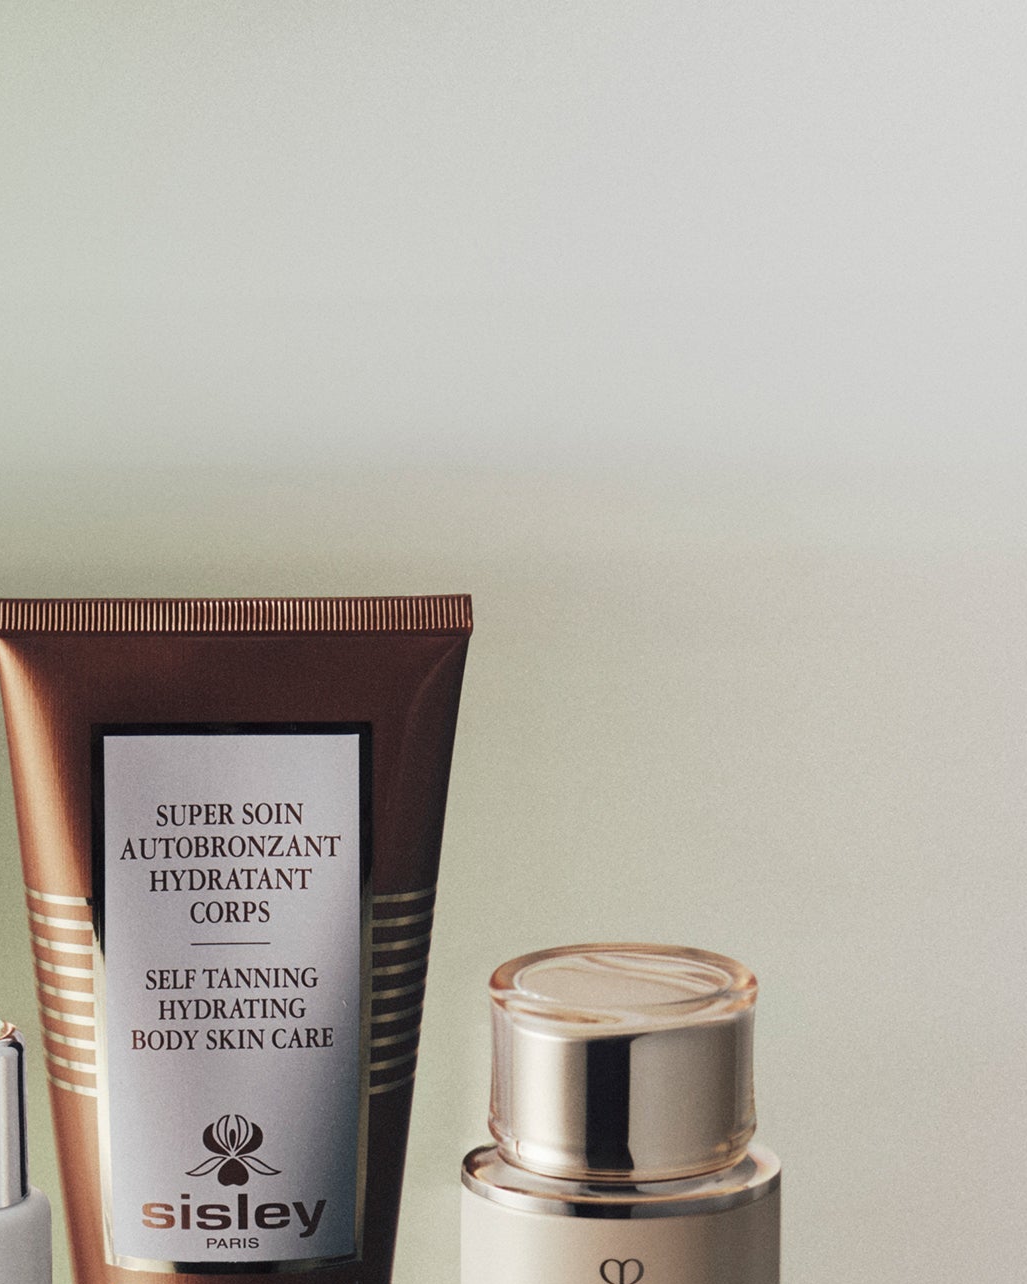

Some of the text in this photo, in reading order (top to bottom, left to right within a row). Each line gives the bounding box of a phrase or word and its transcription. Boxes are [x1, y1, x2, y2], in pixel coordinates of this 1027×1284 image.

[156, 802, 304, 827] SUPER SOIN
[119, 834, 342, 861] AUTOBRONZANT
[149, 867, 313, 892] HYDRATANT
[189, 900, 271, 924] CORPS
[145, 966, 319, 991] SELF TANNING
[158, 997, 307, 1020] HYDRATING
[131, 1027, 334, 1051] BODY SKIN CARE
[141, 1193, 327, 1239] sisley
[206, 1237, 260, 1250] PARIS
